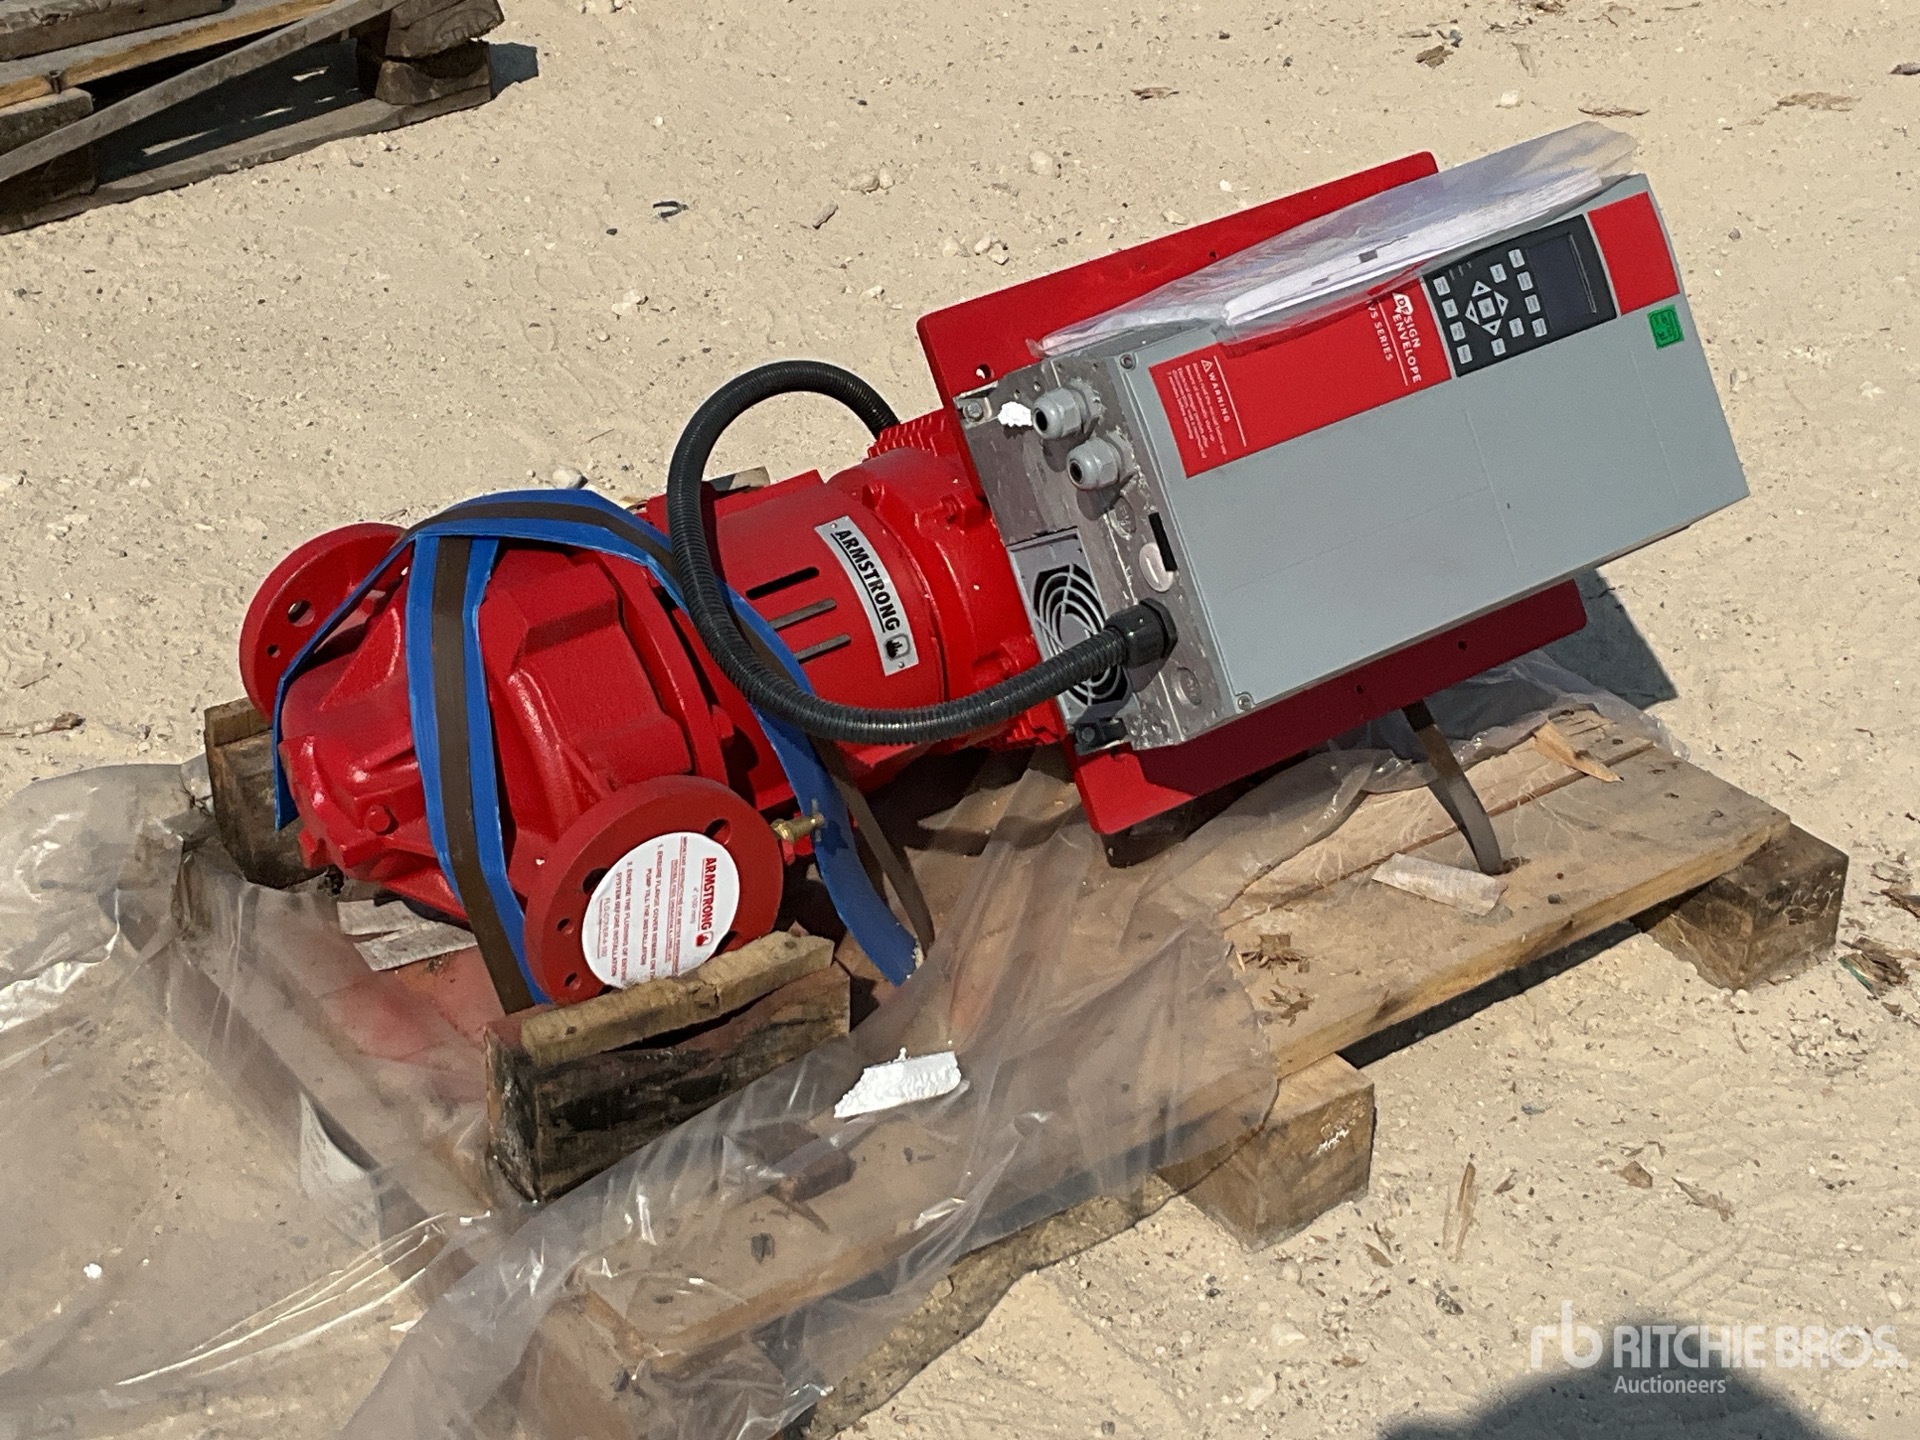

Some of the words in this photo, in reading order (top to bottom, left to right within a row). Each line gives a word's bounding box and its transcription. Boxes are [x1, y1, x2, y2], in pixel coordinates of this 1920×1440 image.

[1373, 321, 1393, 361] SERIES
[1392, 313, 1422, 383] ENVELOPE
[1207, 371, 1231, 422] WARNING
[836, 529, 900, 631] ARMSTRONG
[624, 869, 632, 896] ENSURE
[700, 856, 716, 930] ARMSTRONG
[611, 930, 619, 977] INSTALLATION
